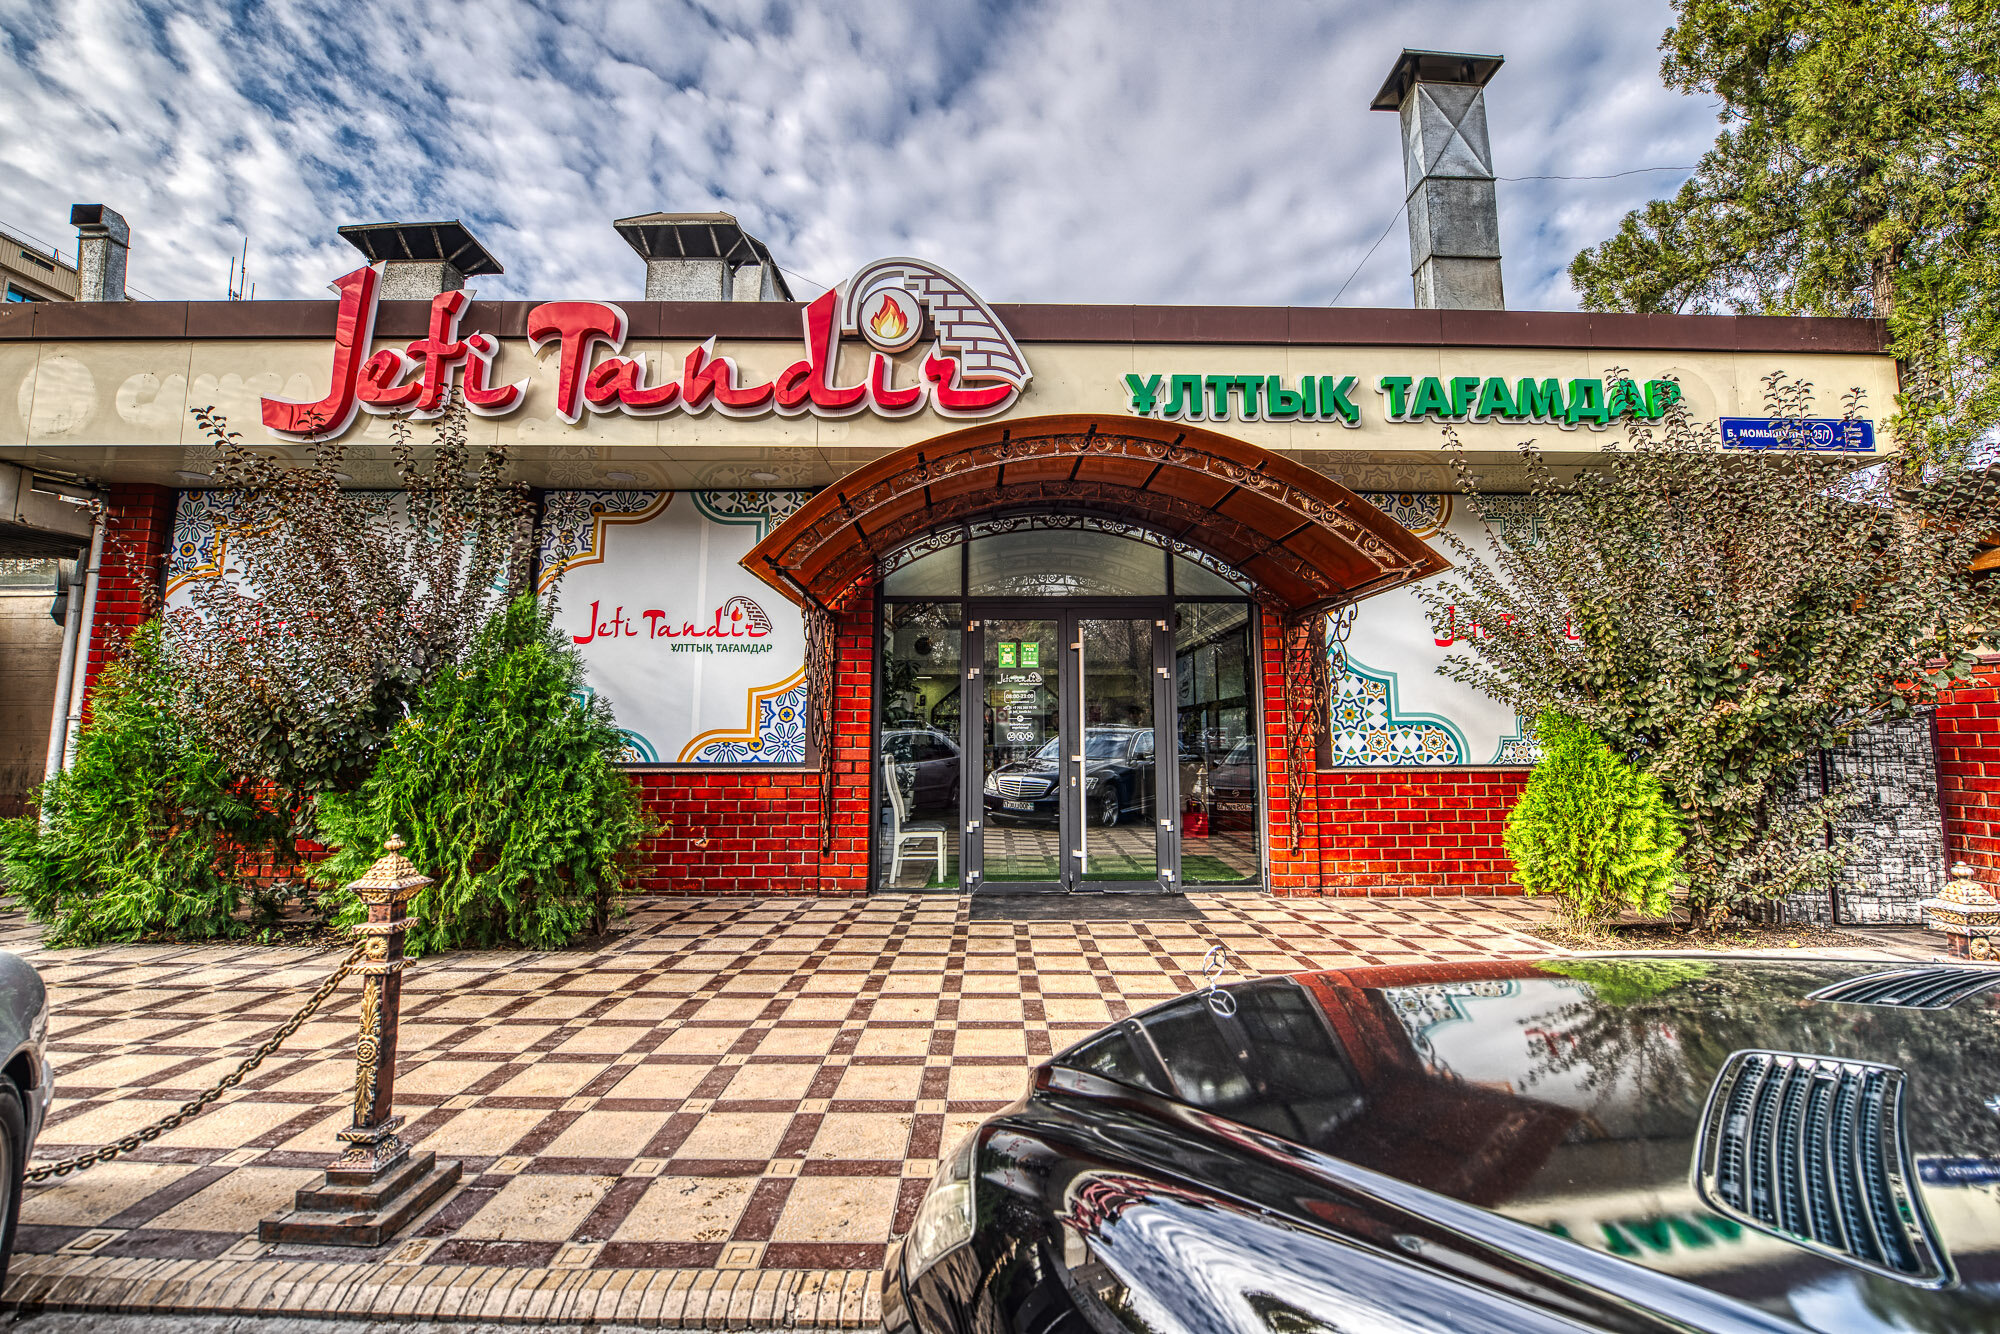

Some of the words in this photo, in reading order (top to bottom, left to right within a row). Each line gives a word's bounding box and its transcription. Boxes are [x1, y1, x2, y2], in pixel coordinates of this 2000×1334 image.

[261, 262, 531, 440] Jeti
[527, 279, 1028, 423] Tandir
[1123, 373, 1360, 426] ҰЛТТЫҚ
[1378, 375, 1682, 427] ТАҒАМДАР
[573, 600, 638, 644] Jeti
[643, 606, 769, 639] Tandir
[671, 644, 713, 654] ҰЛТТЫҚ
[716, 643, 773, 654] ТАҒАМДАР
